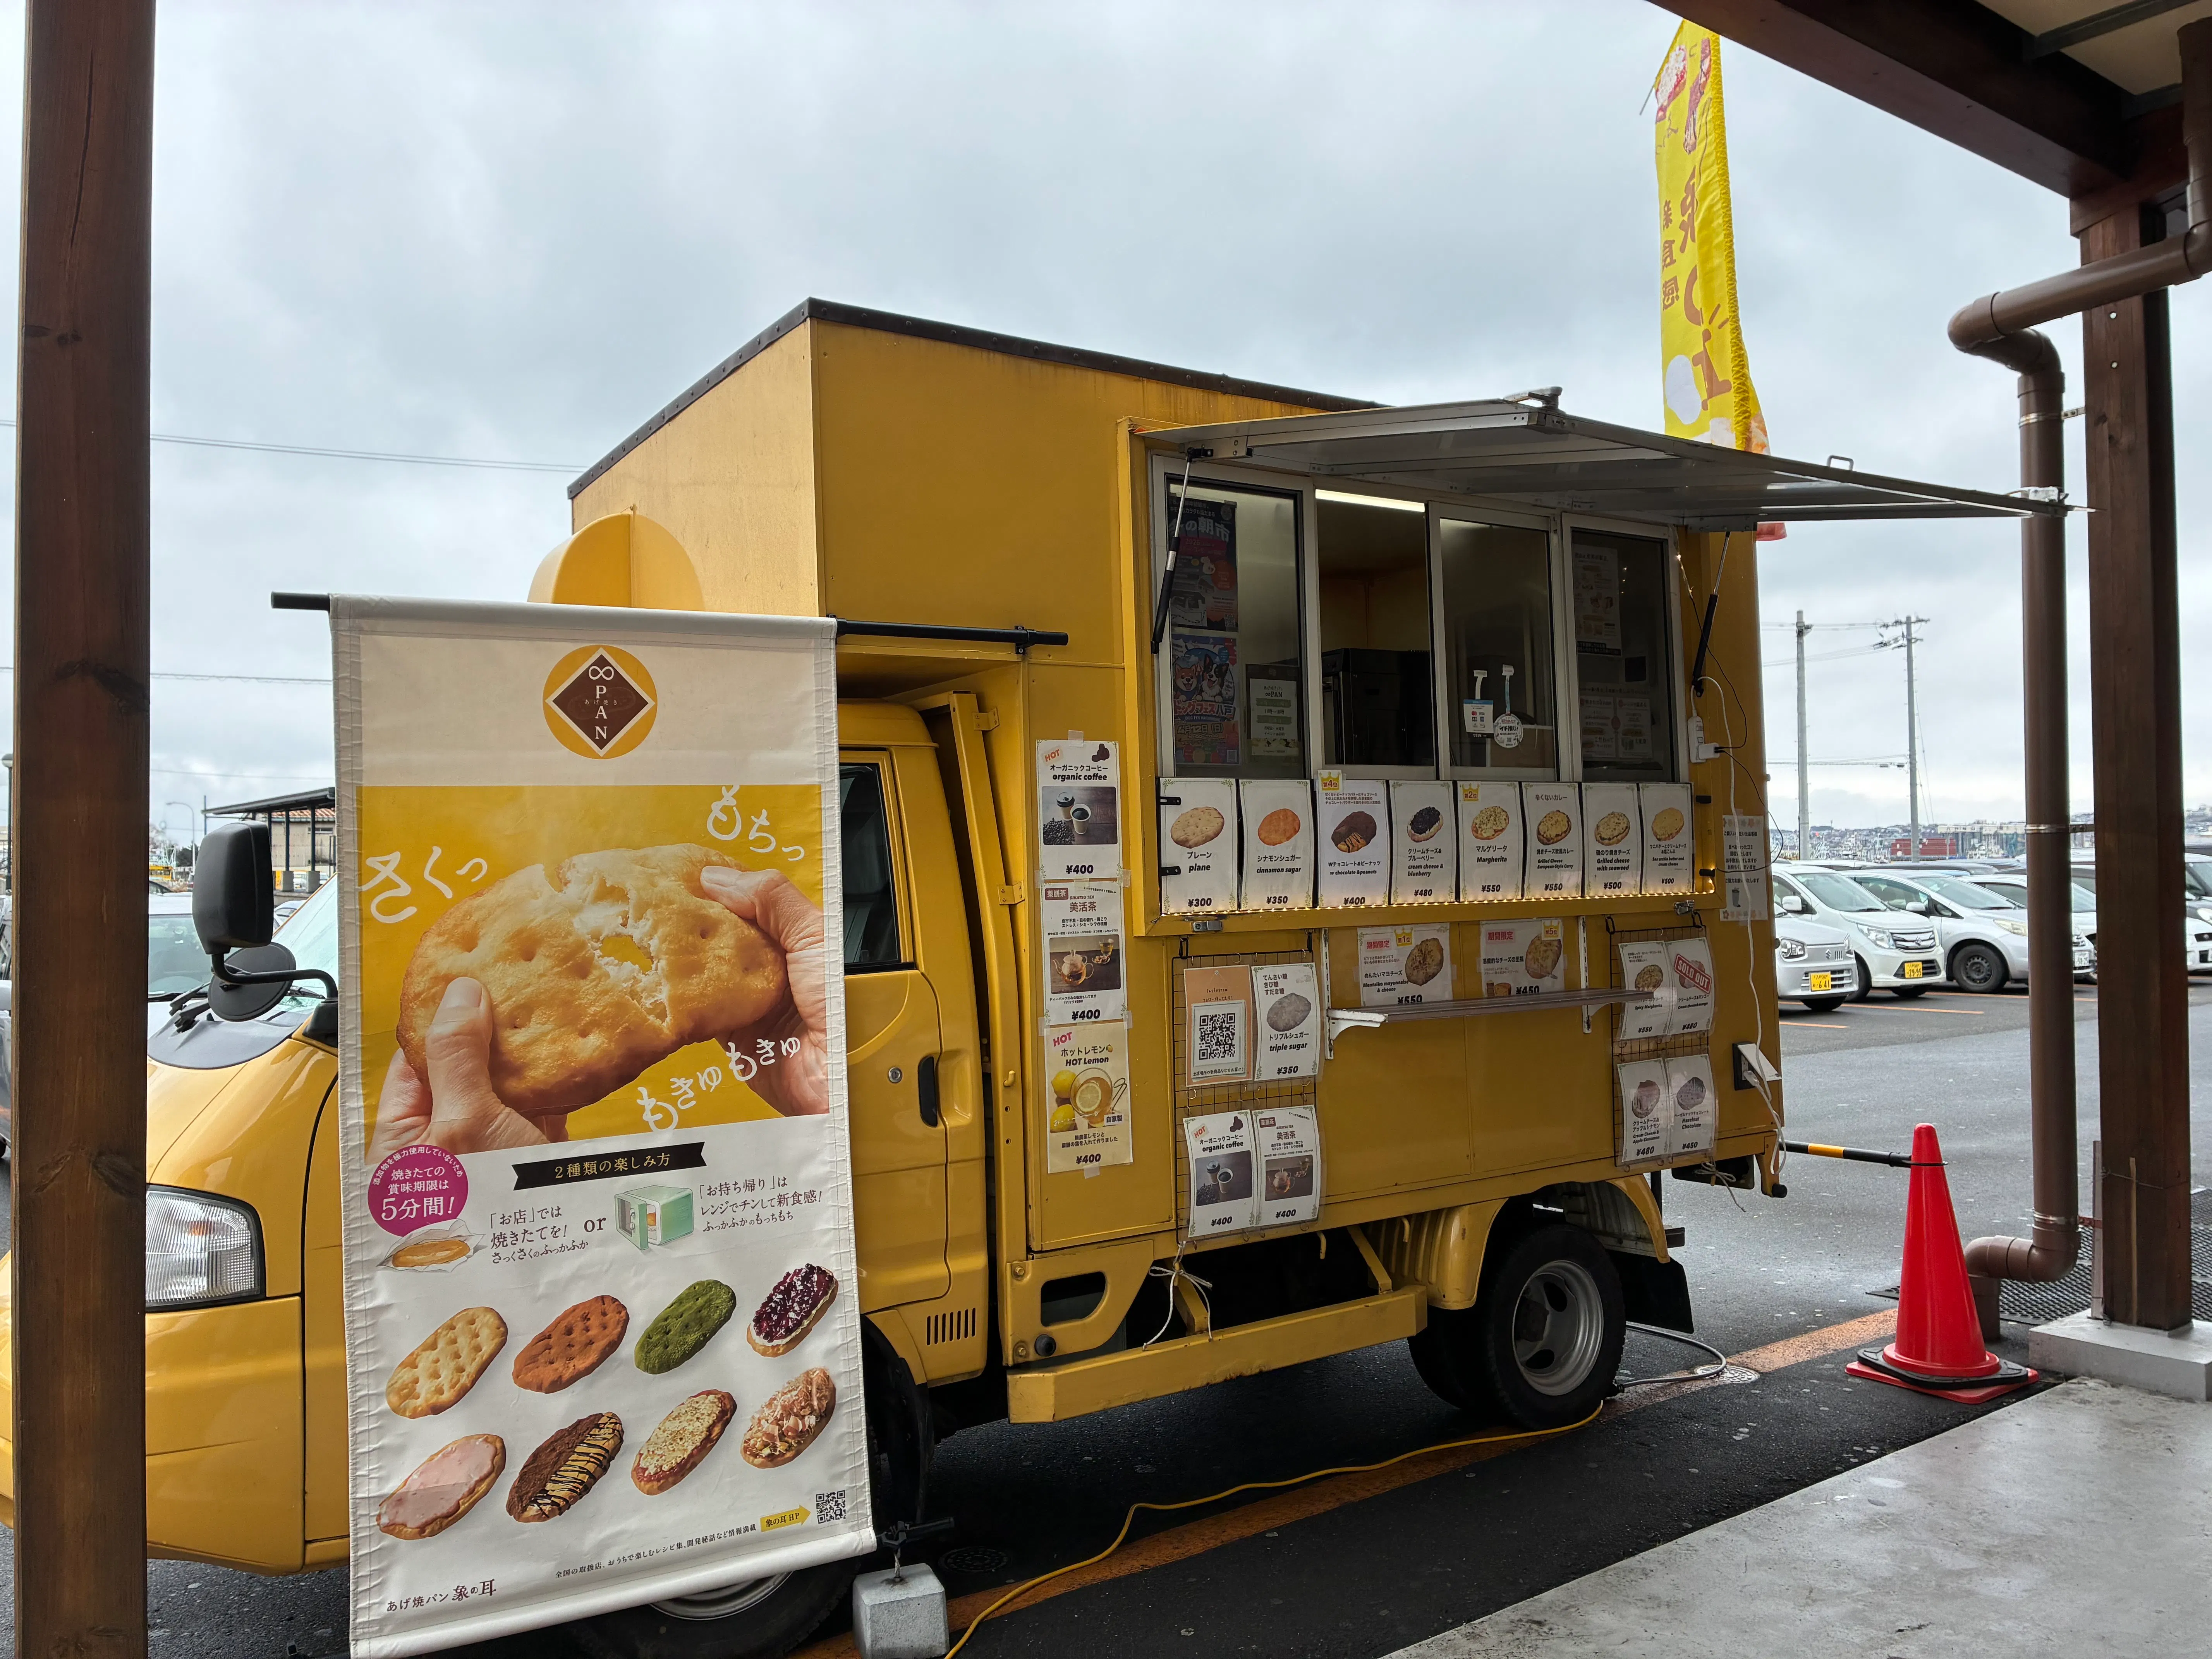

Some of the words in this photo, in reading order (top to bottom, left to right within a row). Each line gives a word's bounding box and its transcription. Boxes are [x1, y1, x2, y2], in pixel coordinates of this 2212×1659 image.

[1044, 749, 1060, 762] HOT
[1053, 773, 1082, 782] organic
[706, 785, 805, 861] もちっ
[1066, 865, 1094, 874] ¥400
[1188, 863, 1211, 873] plane
[361, 846, 488, 924] さくっ
[1481, 884, 1501, 893] ¥550
[1544, 883, 1563, 891] ¥550
[1604, 881, 1622, 890] ¥500
[1414, 889, 1432, 897] ¥480
[1188, 898, 1212, 908] ¥300
[1266, 896, 1288, 905] ¥350
[1343, 897, 1365, 905] ¥400
[1070, 901, 1097, 912] 美活茶
[1487, 931, 1513, 941] 期間限定
[1367, 940, 1390, 949] 期間限定
[1364, 970, 1403, 979] めんたいマヨチーズ
[1678, 960, 1695, 979] SOLD
[1695, 972, 1709, 989] OUT
[1516, 985, 1540, 995] ¥450
[1397, 994, 1422, 1005] ¥550
[1072, 1009, 1100, 1021] ¥400
[1682, 1022, 1698, 1031] ¥480
[1053, 1032, 1072, 1047] HOT
[1269, 1032, 1309, 1041] トリプルシュガー
[1061, 1045, 1106, 1057] ホットレモン
[1269, 1043, 1288, 1053] triple
[1288, 1042, 1308, 1051] sugar
[1065, 1058, 1082, 1066] HOT
[1084, 1057, 1109, 1065] Lemon
[1276, 1065, 1298, 1075] ¥350
[1106, 1115, 1123, 1123] 自家製
[1194, 1125, 1206, 1138] HOT
[1276, 1130, 1296, 1140] 美活茶
[1200, 1134, 1244, 1145] オーガニックコーヒー
[1202, 1142, 1225, 1153] organic
[1225, 1140, 1244, 1149] coffee
[1637, 1146, 1655, 1156] ¥480
[1682, 1141, 1698, 1150] ¥450
[1076, 1153, 1101, 1164] ¥400
[555, 1152, 670, 1179] 2種類の楽しみ方
[391, 1166, 445, 1181] 焼きたての
[388, 1180, 449, 1195] 賞味期限は
[701, 1189, 822, 1216] レンジでチンして新食感!
[381, 1197, 454, 1221] 5分間!
[1275, 1209, 1297, 1219] ¥400
[490, 1206, 562, 1229] 「お店」では
[703, 1209, 793, 1232] ふっかふかのもっちもち
[1211, 1216, 1232, 1227] ¥400
[584, 1217, 606, 1233] or
[490, 1225, 567, 1249] 焼きたてを!
[491, 1240, 589, 1264] さっくさくのふっかふか
[765, 1516, 787, 1528] 象の耳
[788, 1512, 800, 1522] HP
[387, 1594, 448, 1612] あげ焼パン
[452, 1578, 496, 1601] 象の耳
